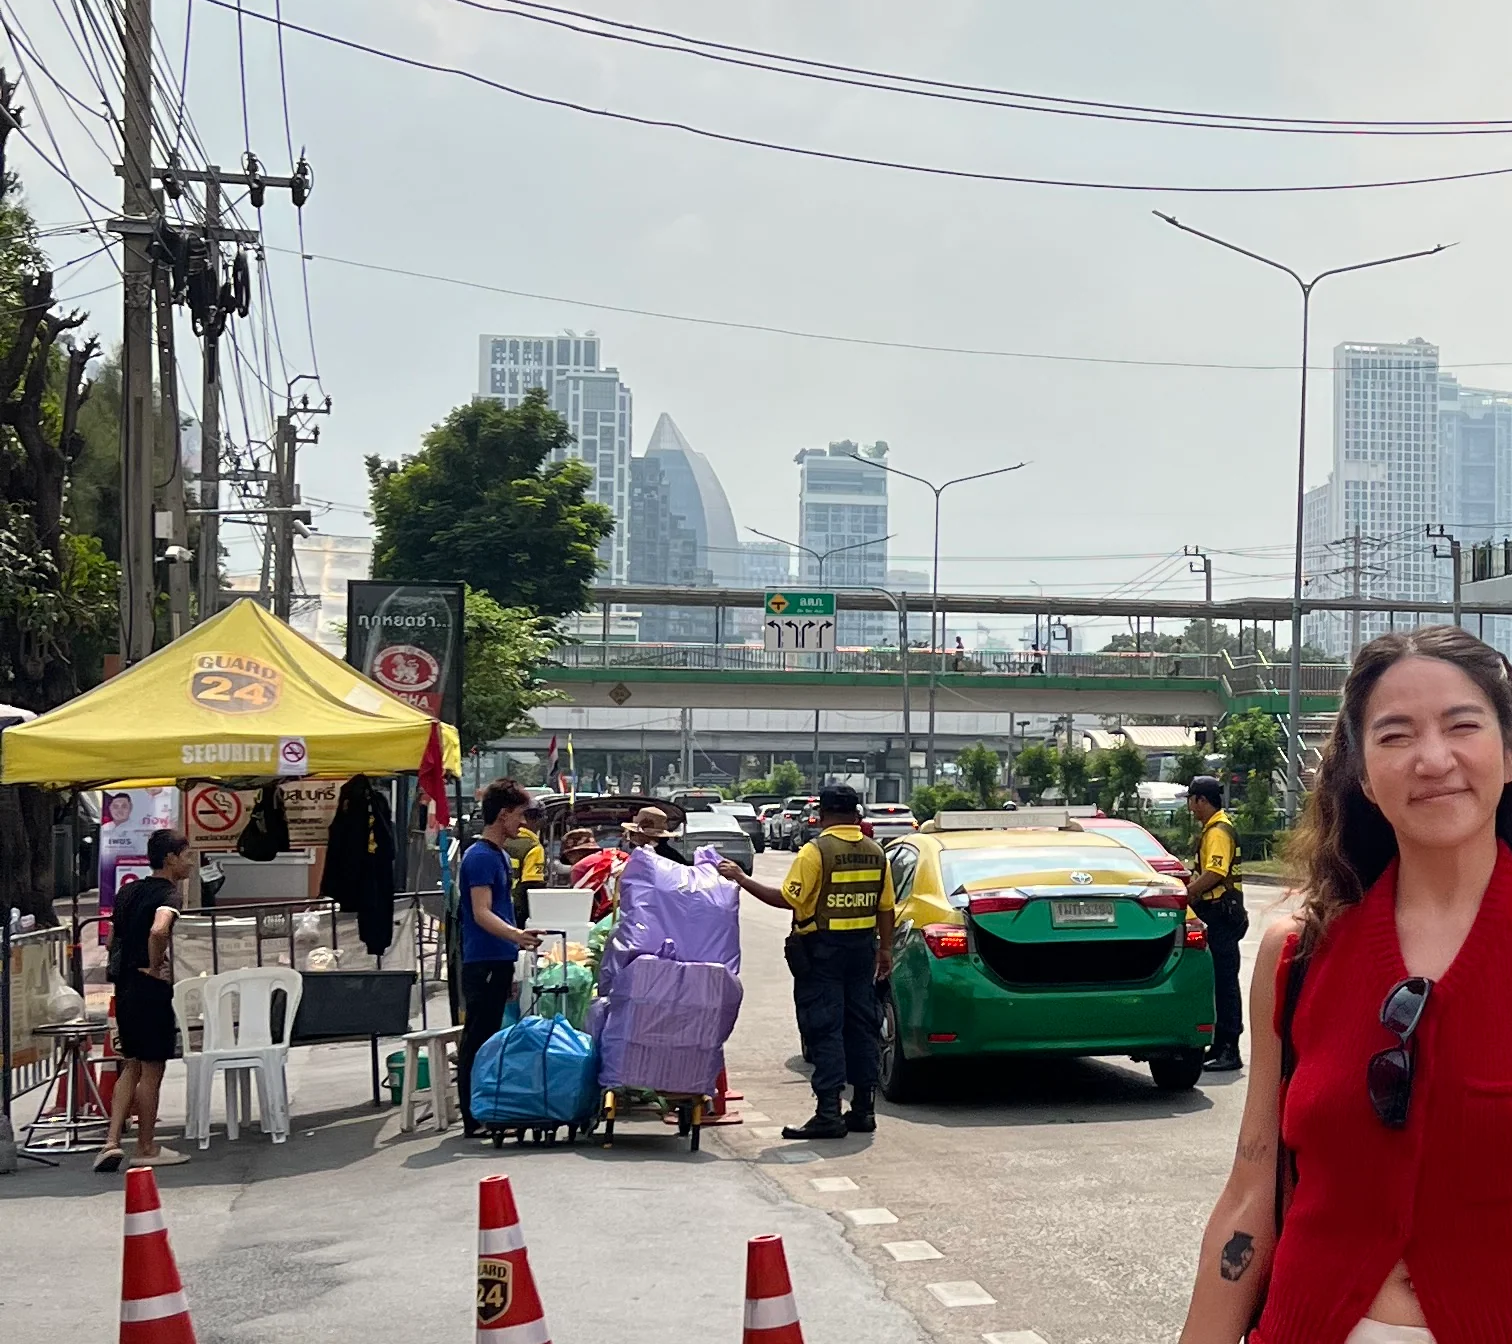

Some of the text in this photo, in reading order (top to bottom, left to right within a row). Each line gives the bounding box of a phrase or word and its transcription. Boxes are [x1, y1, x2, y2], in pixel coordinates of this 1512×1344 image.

[198, 655, 278, 680] GUARD
[196, 675, 268, 706] 24
[181, 742, 275, 764] SECURITY
[835, 853, 880, 866] SECURITY
[479, 1264, 507, 1278] ARD
[477, 1283, 505, 1308] 24
